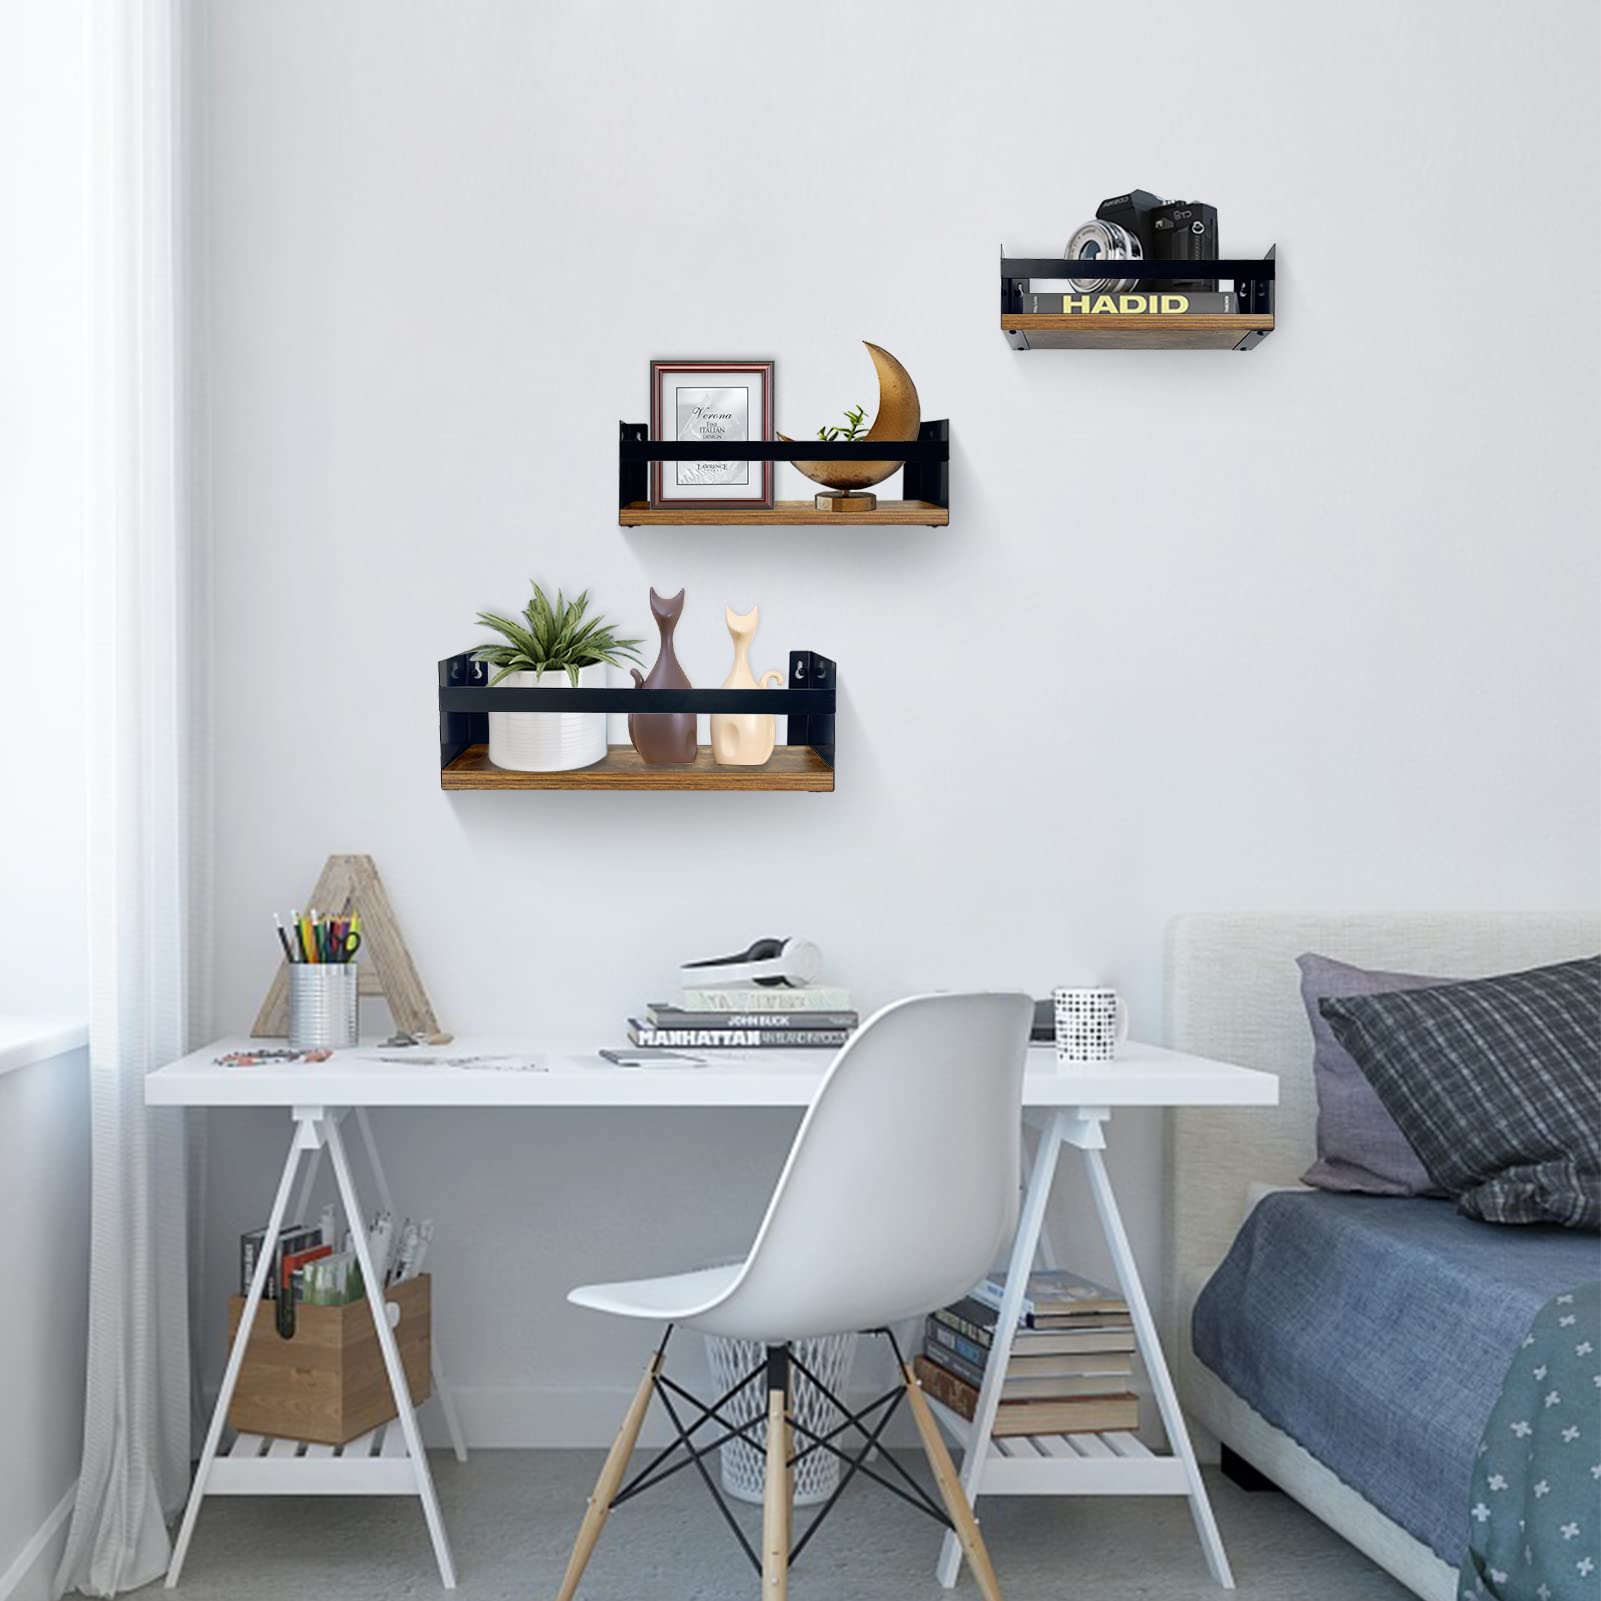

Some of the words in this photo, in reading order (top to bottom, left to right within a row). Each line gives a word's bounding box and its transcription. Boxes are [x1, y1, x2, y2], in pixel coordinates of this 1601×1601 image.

[1062, 294, 1190, 315] HADID
[693, 407, 732, 420] Verona
[638, 1030, 760, 1046] MANHATTAN
